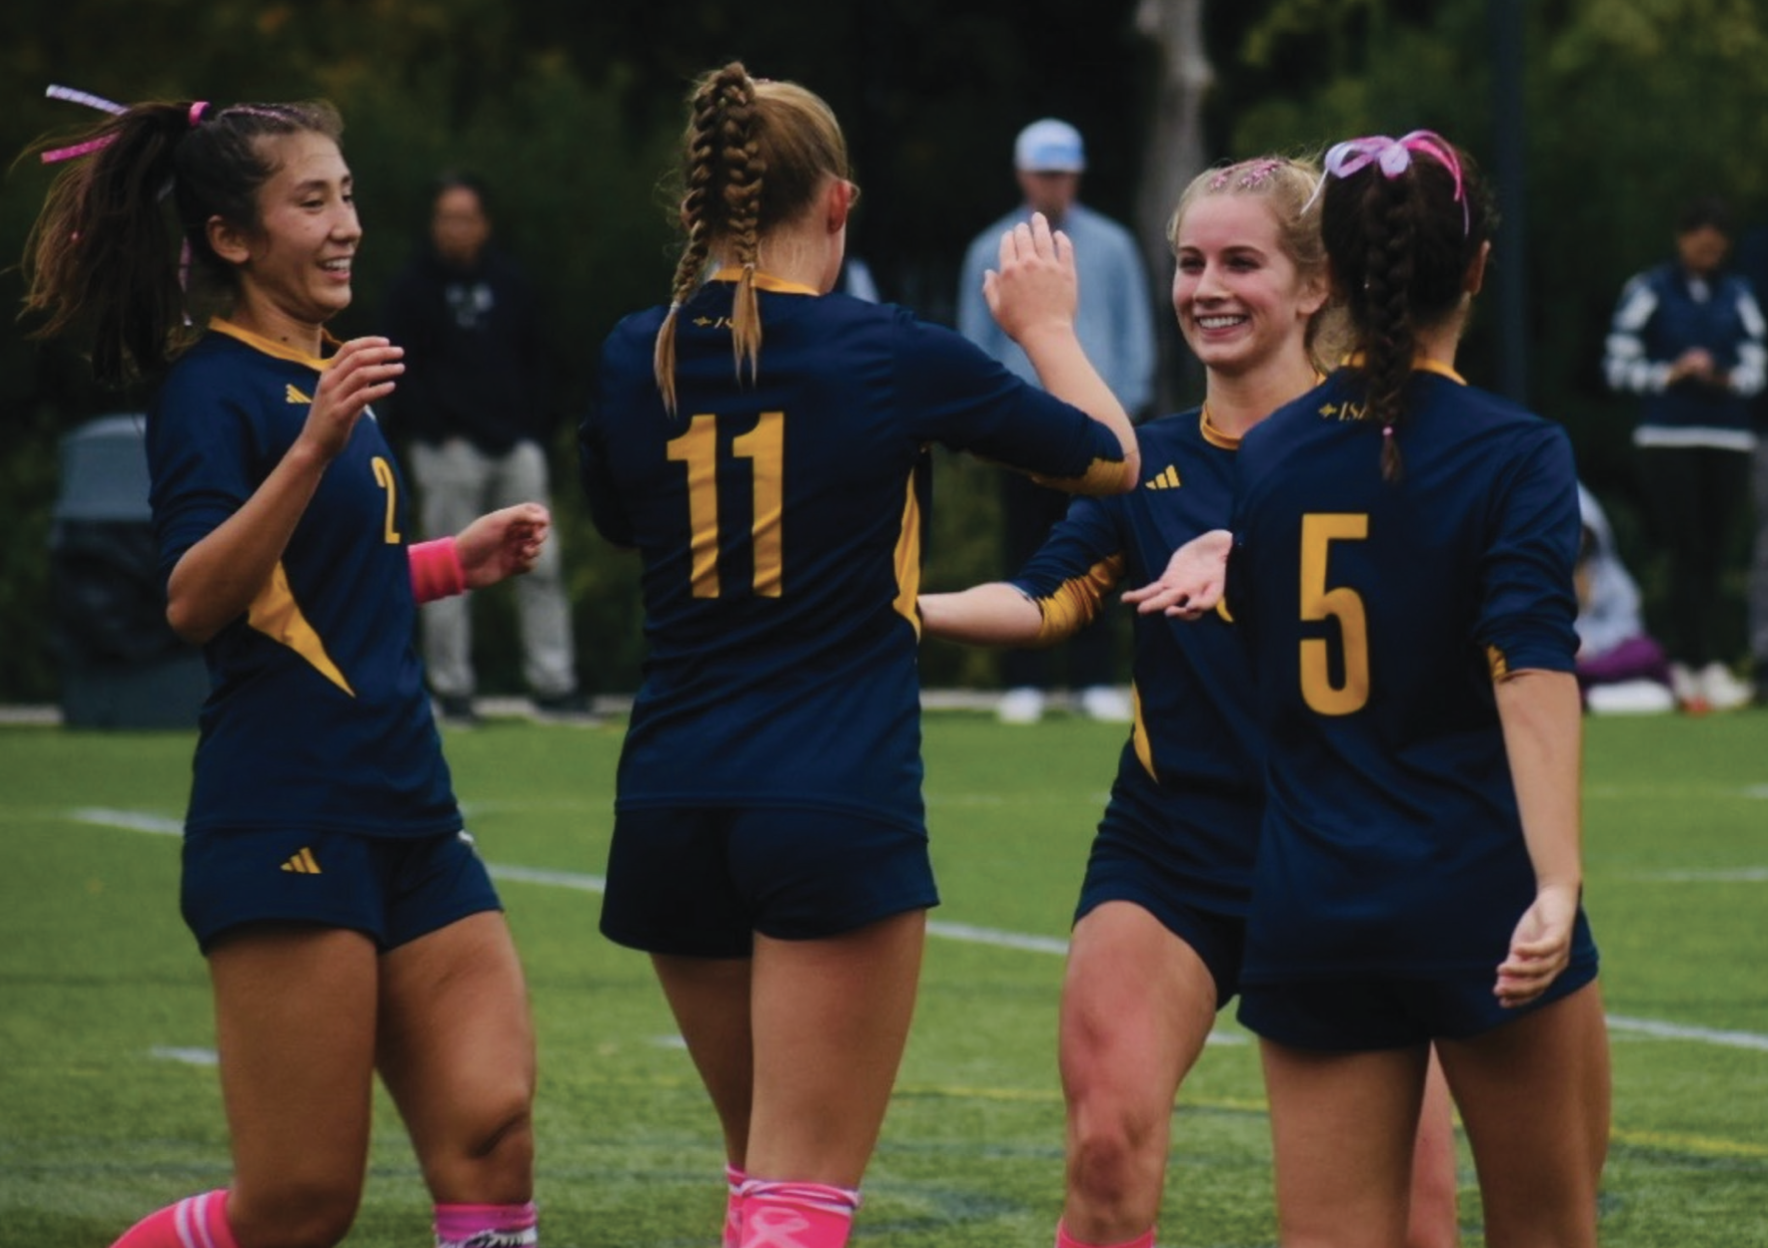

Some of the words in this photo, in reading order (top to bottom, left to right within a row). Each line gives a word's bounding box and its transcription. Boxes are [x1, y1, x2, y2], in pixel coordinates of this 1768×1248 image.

[371, 456, 401, 544] 2
[666, 412, 785, 598] 11
[1300, 513, 1370, 716] 5
